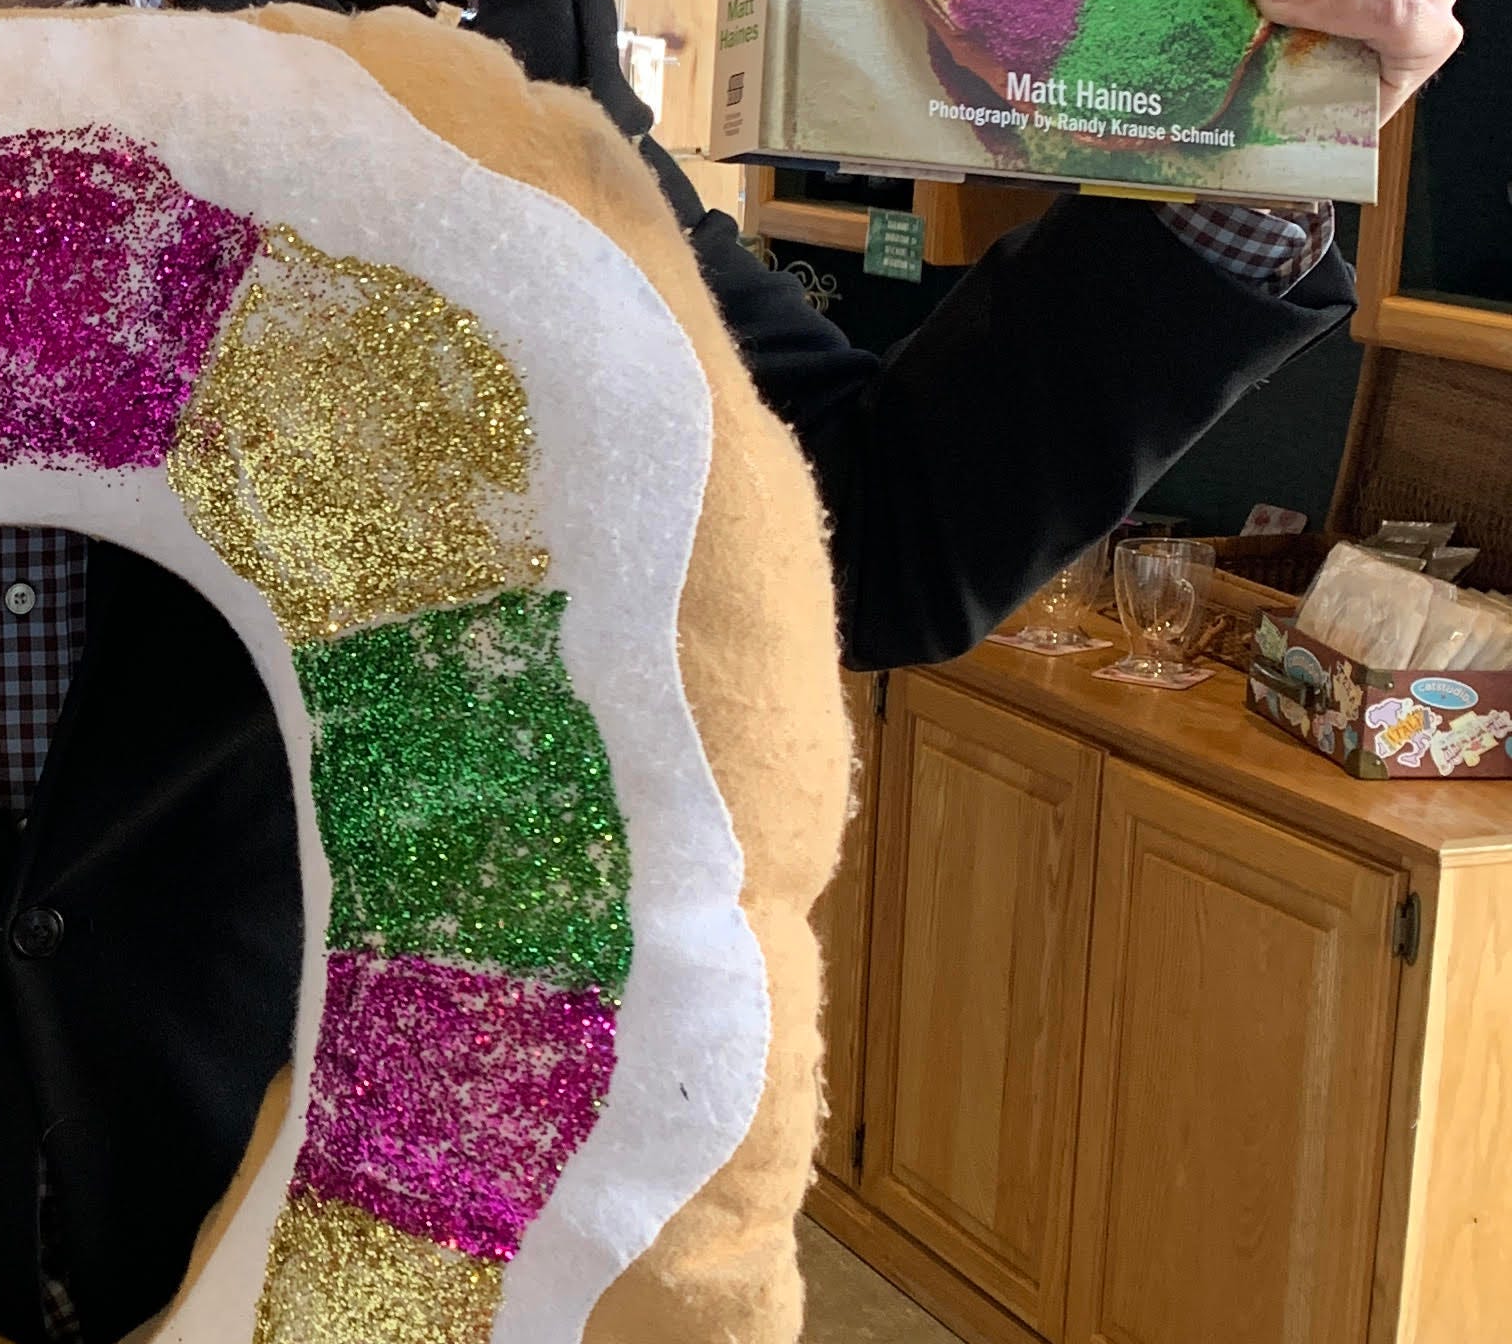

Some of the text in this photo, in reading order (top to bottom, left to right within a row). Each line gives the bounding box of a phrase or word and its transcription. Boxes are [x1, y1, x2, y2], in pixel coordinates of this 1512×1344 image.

[720, 23, 759, 50] Haines
[1007, 72, 1162, 116] Matt Haines
[929, 100, 1237, 147] Photography by Randy Krause Schmidt
